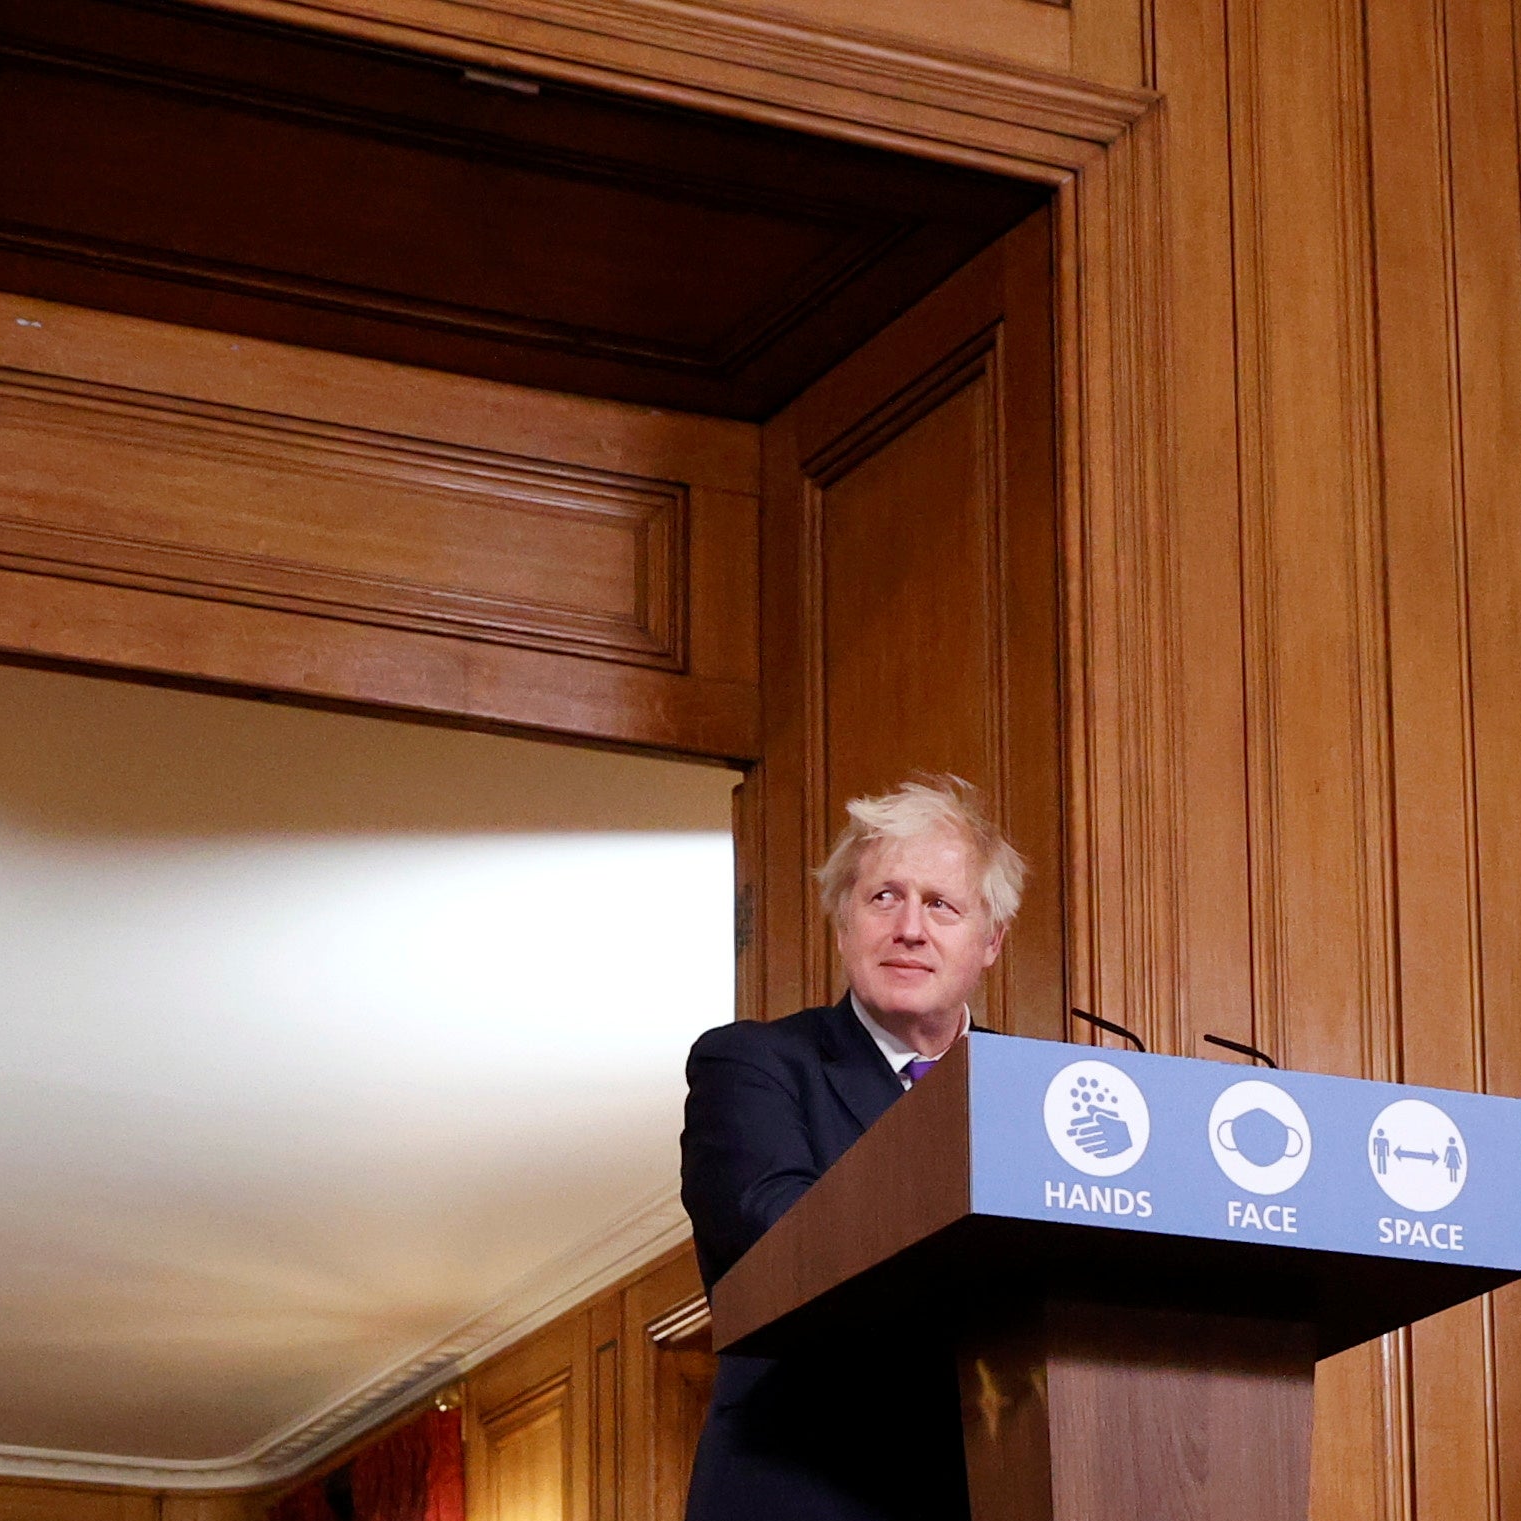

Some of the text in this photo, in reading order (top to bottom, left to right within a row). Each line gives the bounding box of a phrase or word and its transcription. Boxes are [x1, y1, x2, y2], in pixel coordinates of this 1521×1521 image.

[1044, 1180, 1465, 1252] HANDS FACE SPACE
